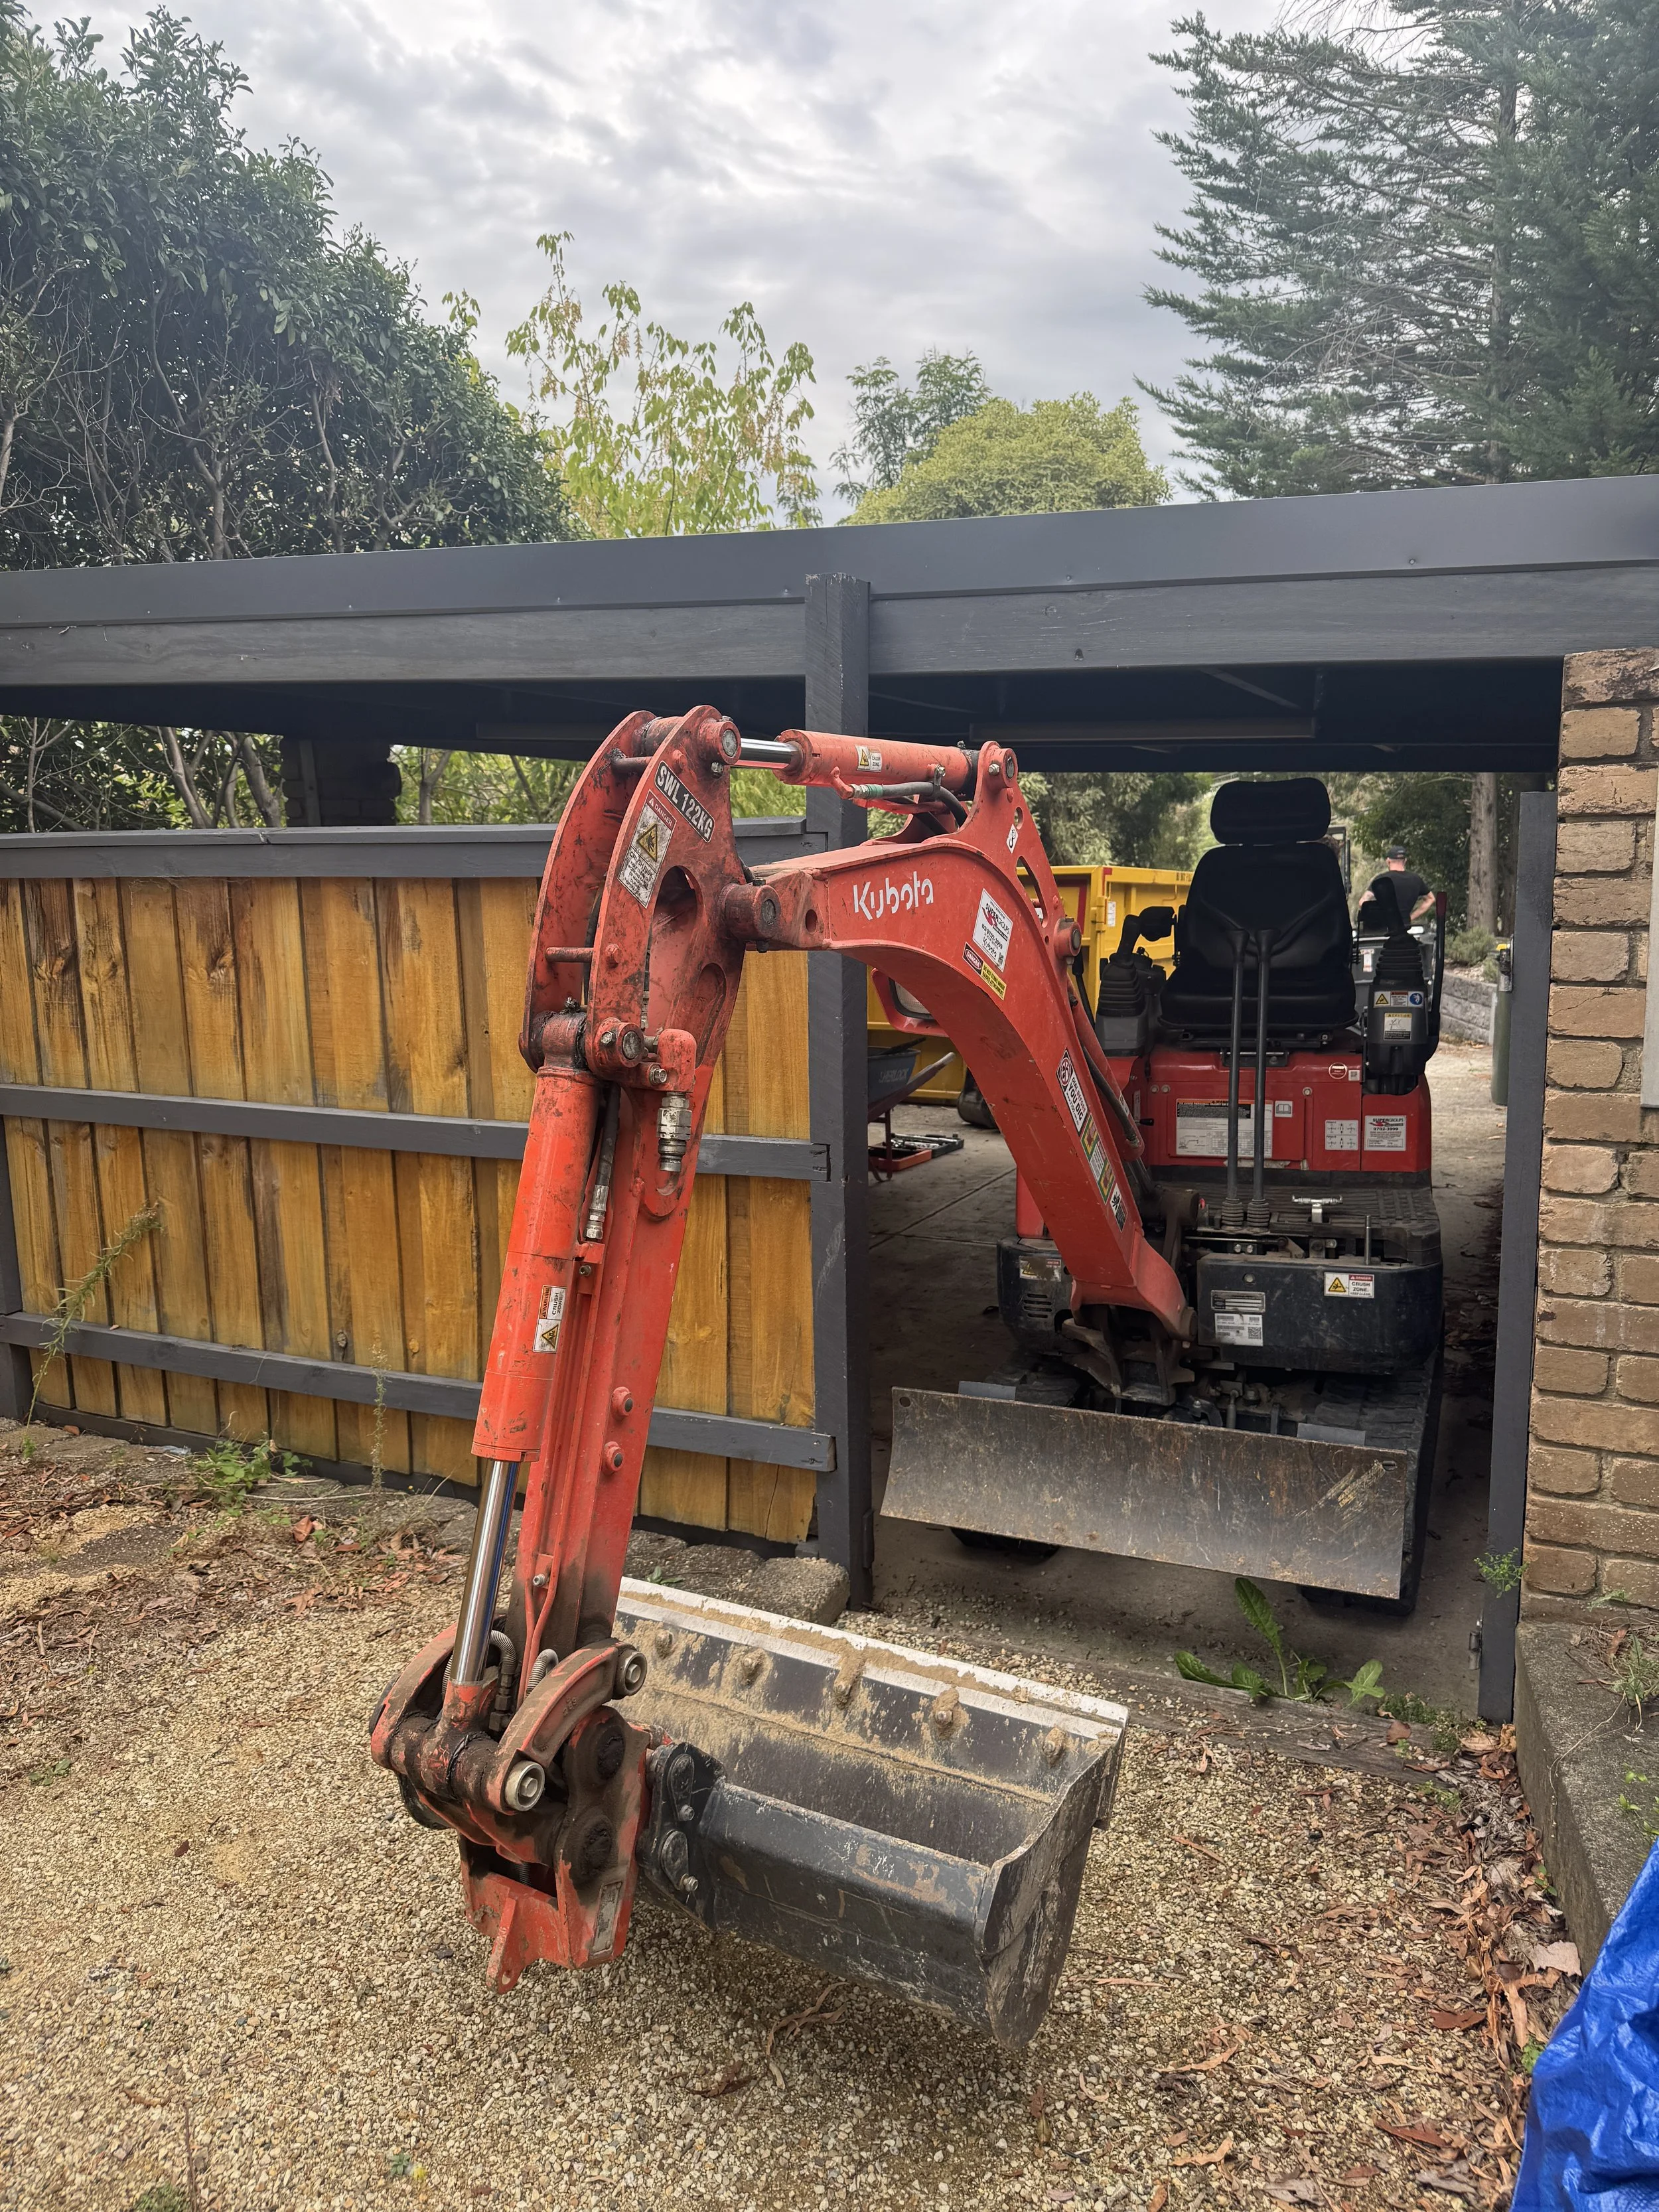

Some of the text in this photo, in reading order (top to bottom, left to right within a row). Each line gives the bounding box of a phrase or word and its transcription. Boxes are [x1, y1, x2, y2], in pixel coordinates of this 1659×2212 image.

[654, 802, 672, 827] DANGER
[657, 765, 713, 840] SWL 122KG
[629, 849, 644, 869] CRUSH
[853, 871, 934, 921] Kubota
[966, 949, 980, 968] DANGER
[1068, 1081, 1084, 1123] YOU DIG
[1076, 1088, 1086, 1114] BEFORE
[541, 1288, 550, 1311] WARNING
